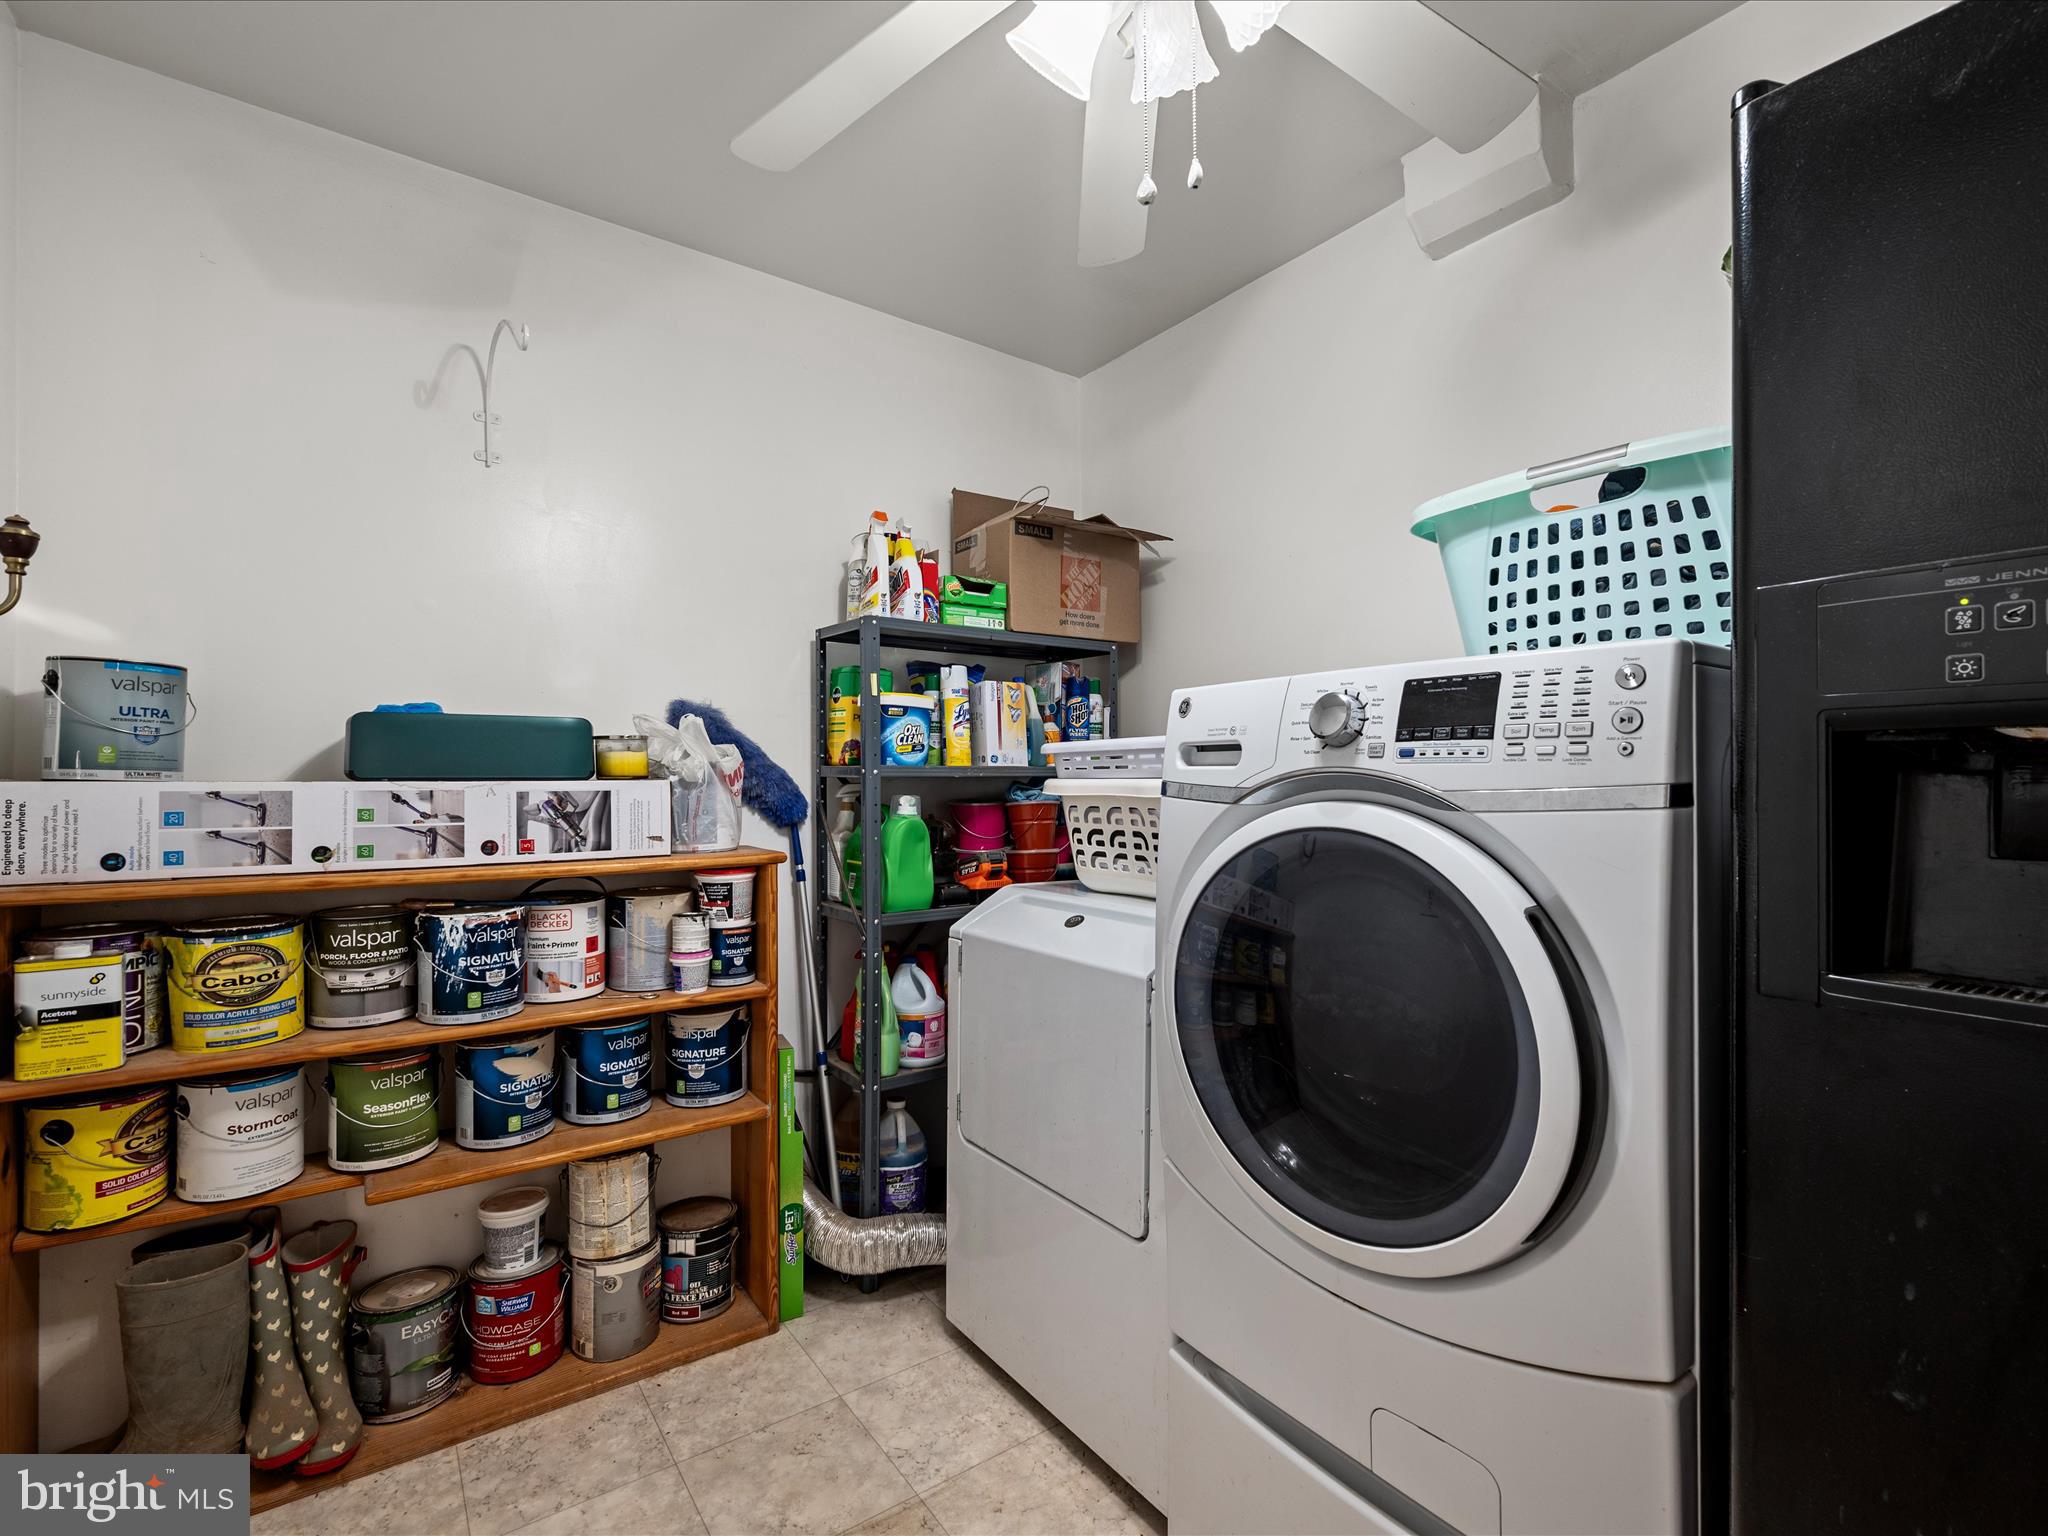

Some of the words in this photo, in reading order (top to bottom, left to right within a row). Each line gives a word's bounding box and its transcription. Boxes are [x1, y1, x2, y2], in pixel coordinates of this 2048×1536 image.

[1017, 524, 1051, 539] SMALL
[957, 537, 978, 551] SMALL
[1062, 561, 1101, 605] HOME
[1076, 581, 1100, 611] DEPOT
[1065, 611, 1078, 619] How
[1079, 612, 1096, 621] doers
[1059, 619, 1070, 628] get
[1070, 620, 1085, 628] more
[1086, 620, 1100, 629] done
[111, 675, 178, 697] valspar
[119, 706, 171, 720] ULTRA
[1072, 703, 1088, 714] HOT
[1070, 711, 1089, 724] SHOT
[903, 724, 920, 734] OXI
[896, 733, 924, 746] CLEAN
[3, 799, 15, 819] deep
[3, 821, 12, 829] to
[16, 801, 28, 850] everywhere.
[1, 831, 14, 876] Engineered
[15, 852, 27, 876] clean,
[530, 912, 568, 921] BLACK+
[530, 920, 569, 929] DECKER
[330, 929, 402, 951] valspar
[468, 926, 519, 944] valspar
[320, 953, 349, 962] PORCH,
[350, 951, 380, 960] FLOOR
[389, 947, 409, 956] PATIO
[722, 945, 753, 956] SIGNATURE
[353, 957, 385, 965] CONCRETE
[201, 968, 281, 990] Cabot
[40, 987, 107, 1002] sunnyside
[41, 1009, 77, 1019] Acetone
[185, 1013, 201, 1021] SOLID
[202, 1011, 226, 1020] COLOR
[226, 1008, 258, 1019] ACRYLIC
[259, 1003, 281, 1014] SIDING
[280, 999, 296, 1010] STAIN
[608, 1033, 648, 1051] valspar
[671, 1047, 727, 1059] SIGNATURE
[370, 1068, 428, 1091] valspar
[235, 1085, 297, 1111] valspar
[363, 1092, 432, 1115] SeasonFlex
[227, 1108, 298, 1136] StormCoat
[370, 1111, 394, 1119] EXTERIOR
[247, 1131, 273, 1140] EXTERIOR
[102, 1178, 126, 1190] SOLID
[127, 1169, 150, 1182] COLOR
[785, 1210, 794, 1232] PET
[784, 1231, 799, 1264] Swiffer
[501, 1296, 529, 1306] SHERWIN
[670, 1293, 696, 1303] FENCE
[698, 1285, 724, 1301] PAINT
[500, 1302, 529, 1313] WILLIAMS
